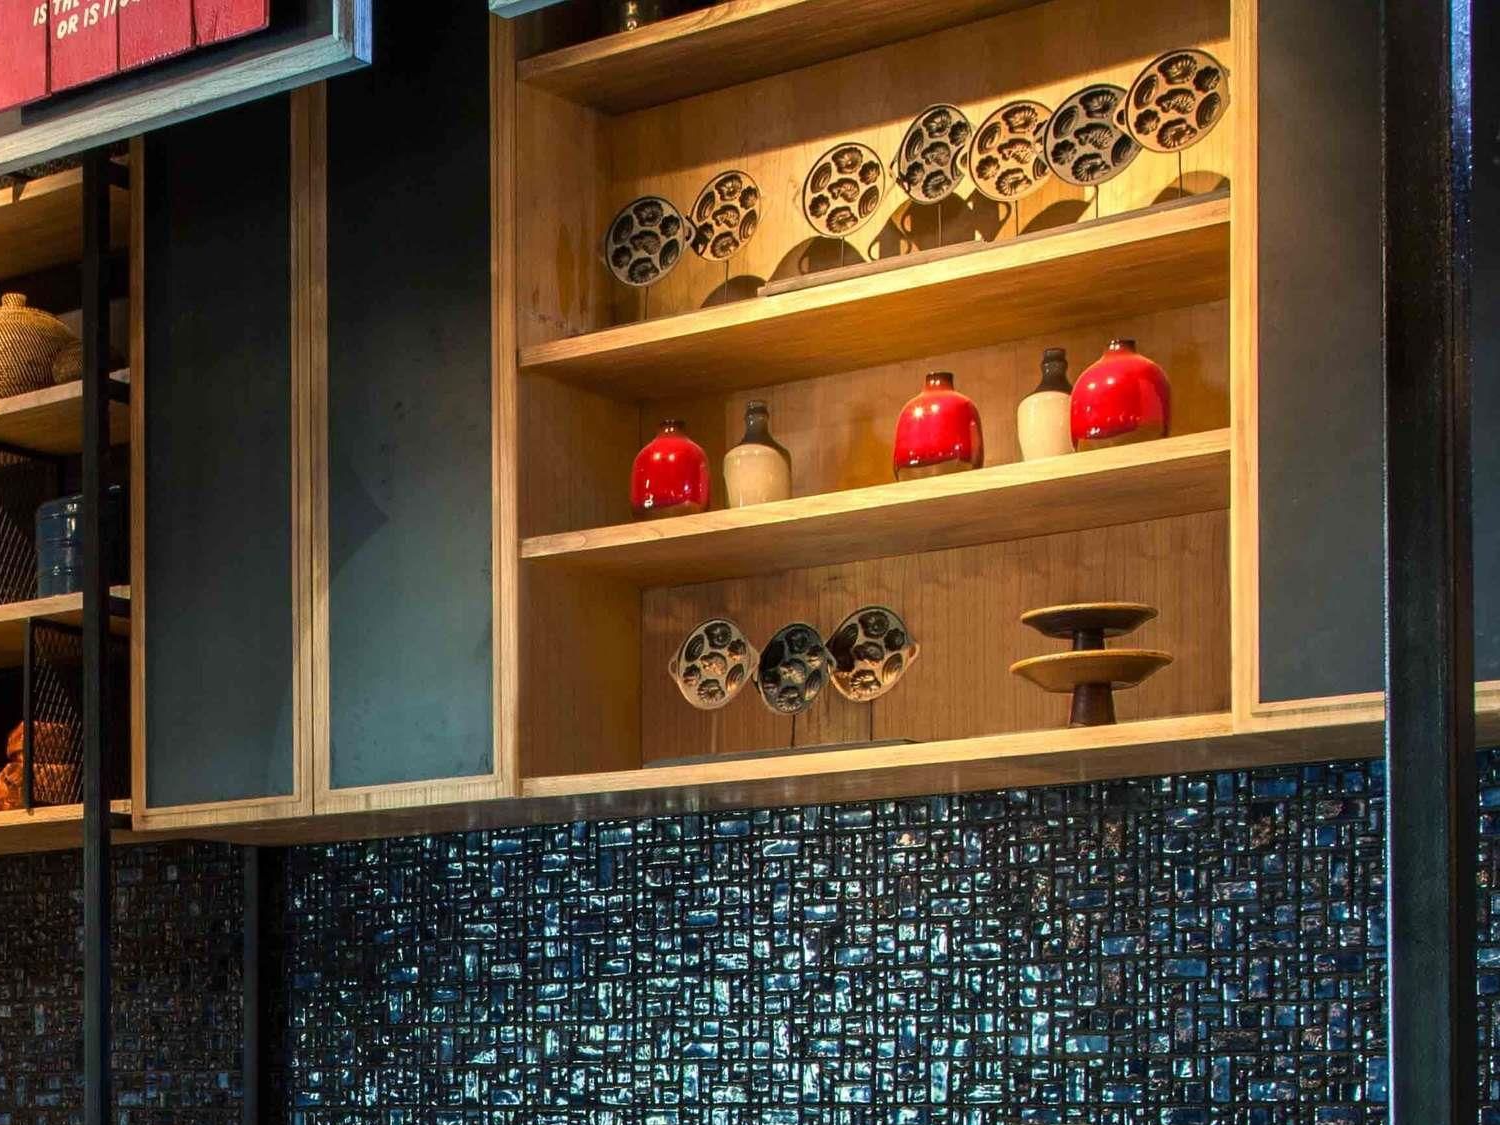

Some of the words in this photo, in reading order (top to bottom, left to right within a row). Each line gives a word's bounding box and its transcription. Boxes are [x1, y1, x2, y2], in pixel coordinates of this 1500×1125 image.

[33, 3, 47, 27] IS
[56, 13, 78, 39] OR
[83, 3, 100, 28] IS
